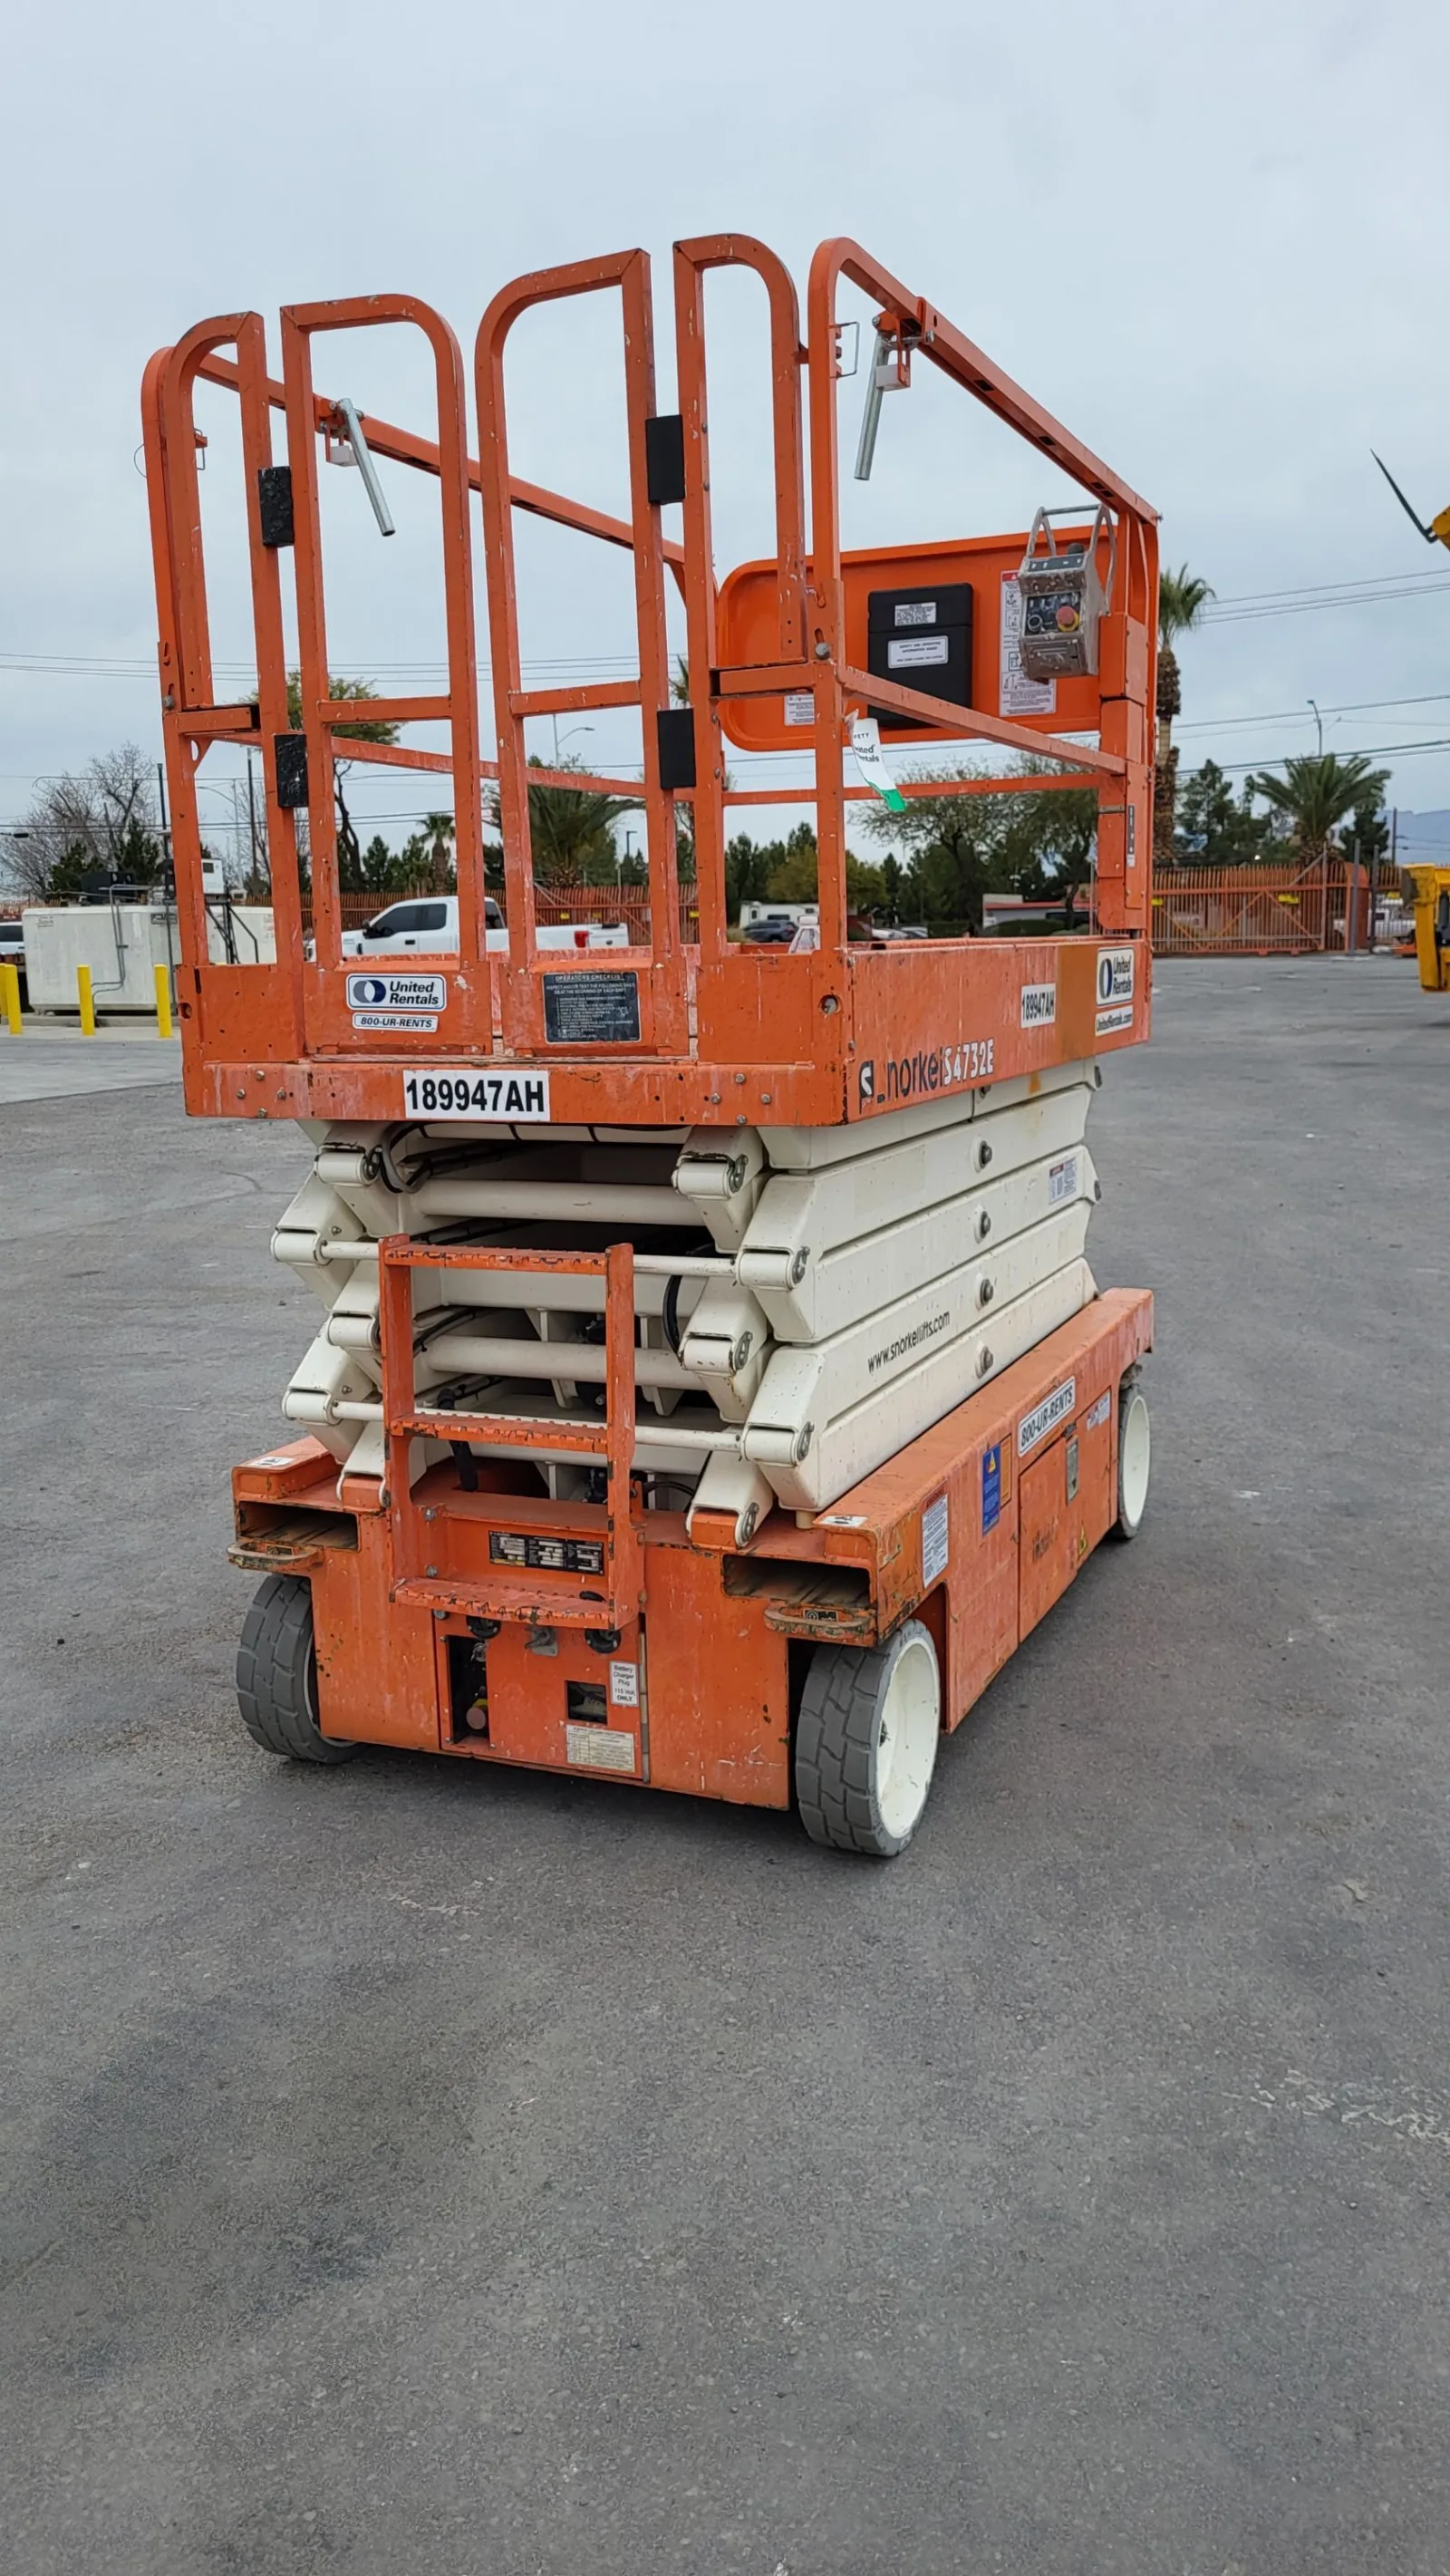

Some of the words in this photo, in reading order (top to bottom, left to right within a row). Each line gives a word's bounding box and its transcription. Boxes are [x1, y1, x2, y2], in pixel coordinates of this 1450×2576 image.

[1113, 955, 1132, 975] United
[390, 981, 435, 993] United
[1113, 977, 1132, 995] Rentals
[390, 993, 440, 1005] Rentals
[1022, 991, 1055, 1021] 189947AH
[361, 1017, 432, 1028] 800-UR-RENTS
[406, 1078, 545, 1113] 189947AH
[867, 1311, 951, 1374] www.snorkellifts.com
[1020, 1385, 1073, 1448] 800-UR-RENTS
